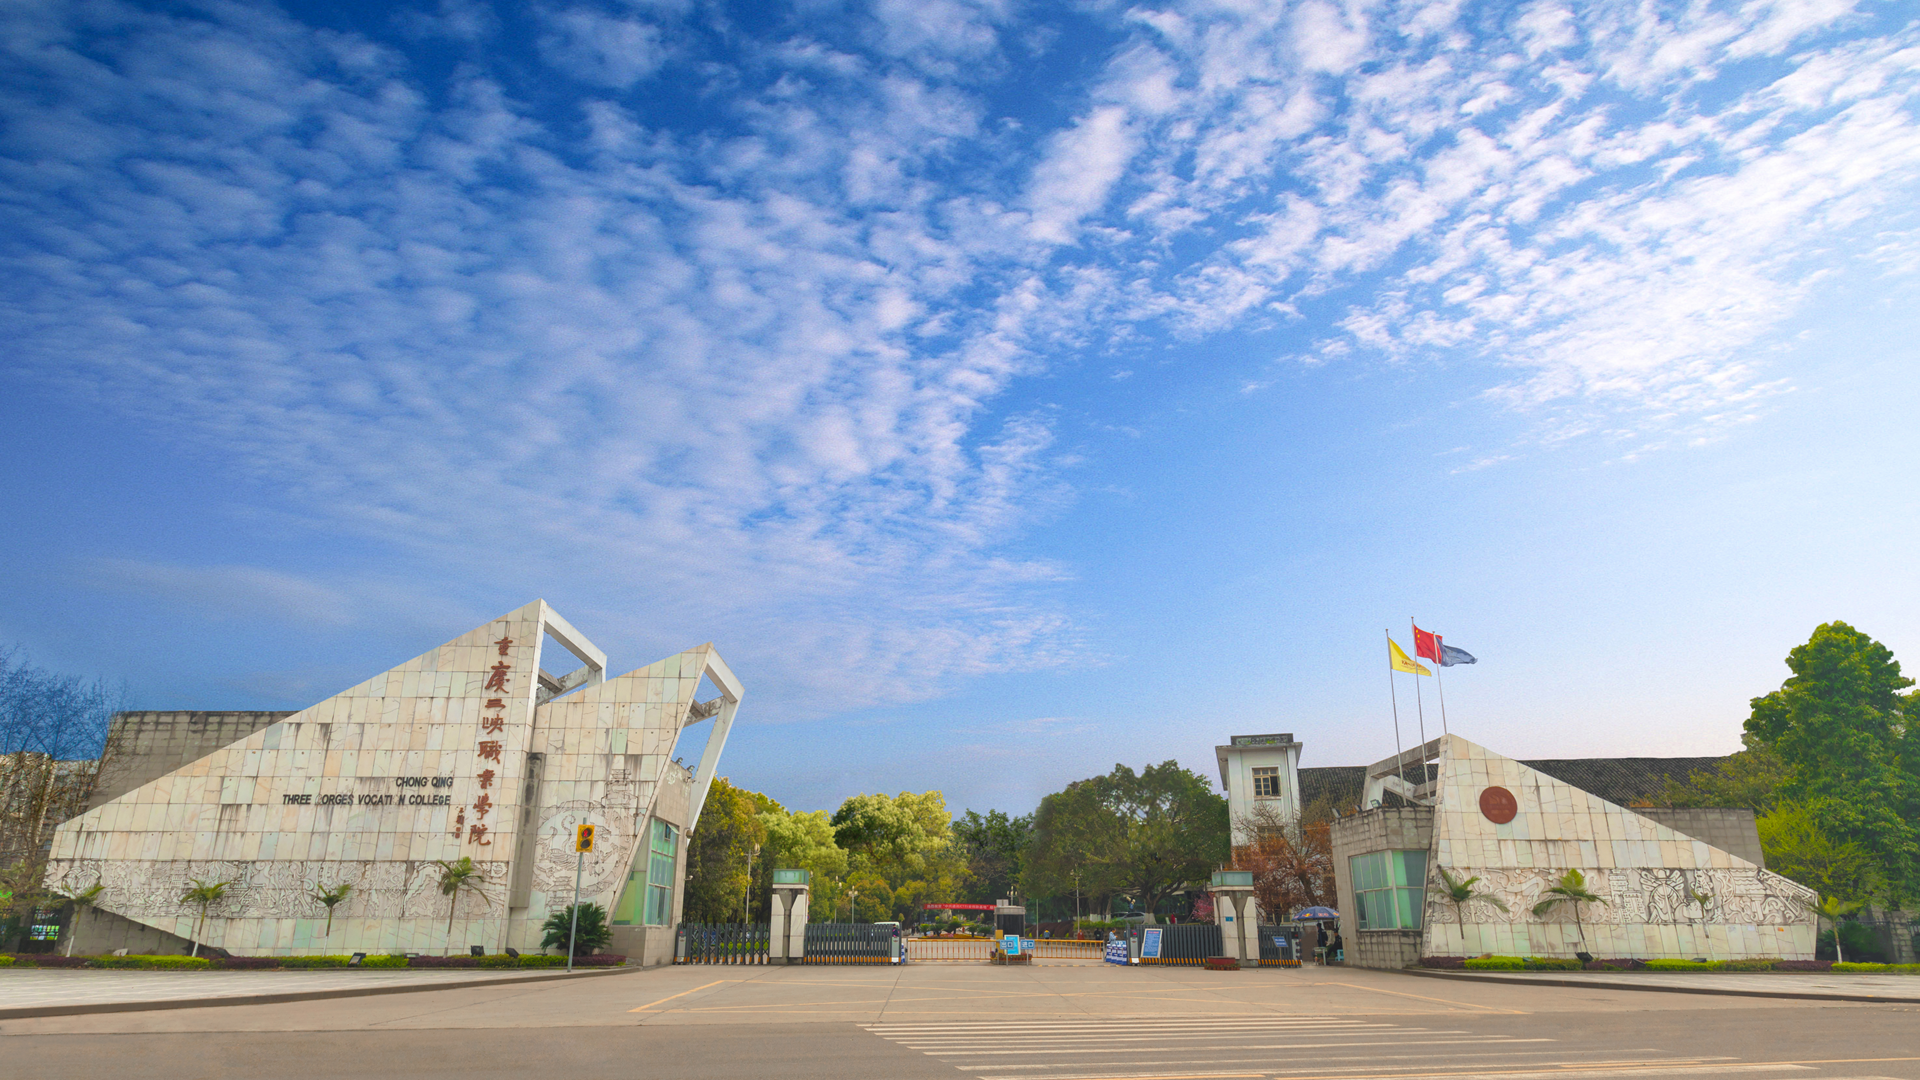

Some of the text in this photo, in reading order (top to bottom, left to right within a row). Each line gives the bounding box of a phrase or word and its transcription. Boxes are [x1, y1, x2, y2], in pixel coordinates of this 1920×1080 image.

[395, 776, 454, 788] CHONG QING
[282, 794, 451, 806] THREE ORGES VOCATIN COLLEGE
